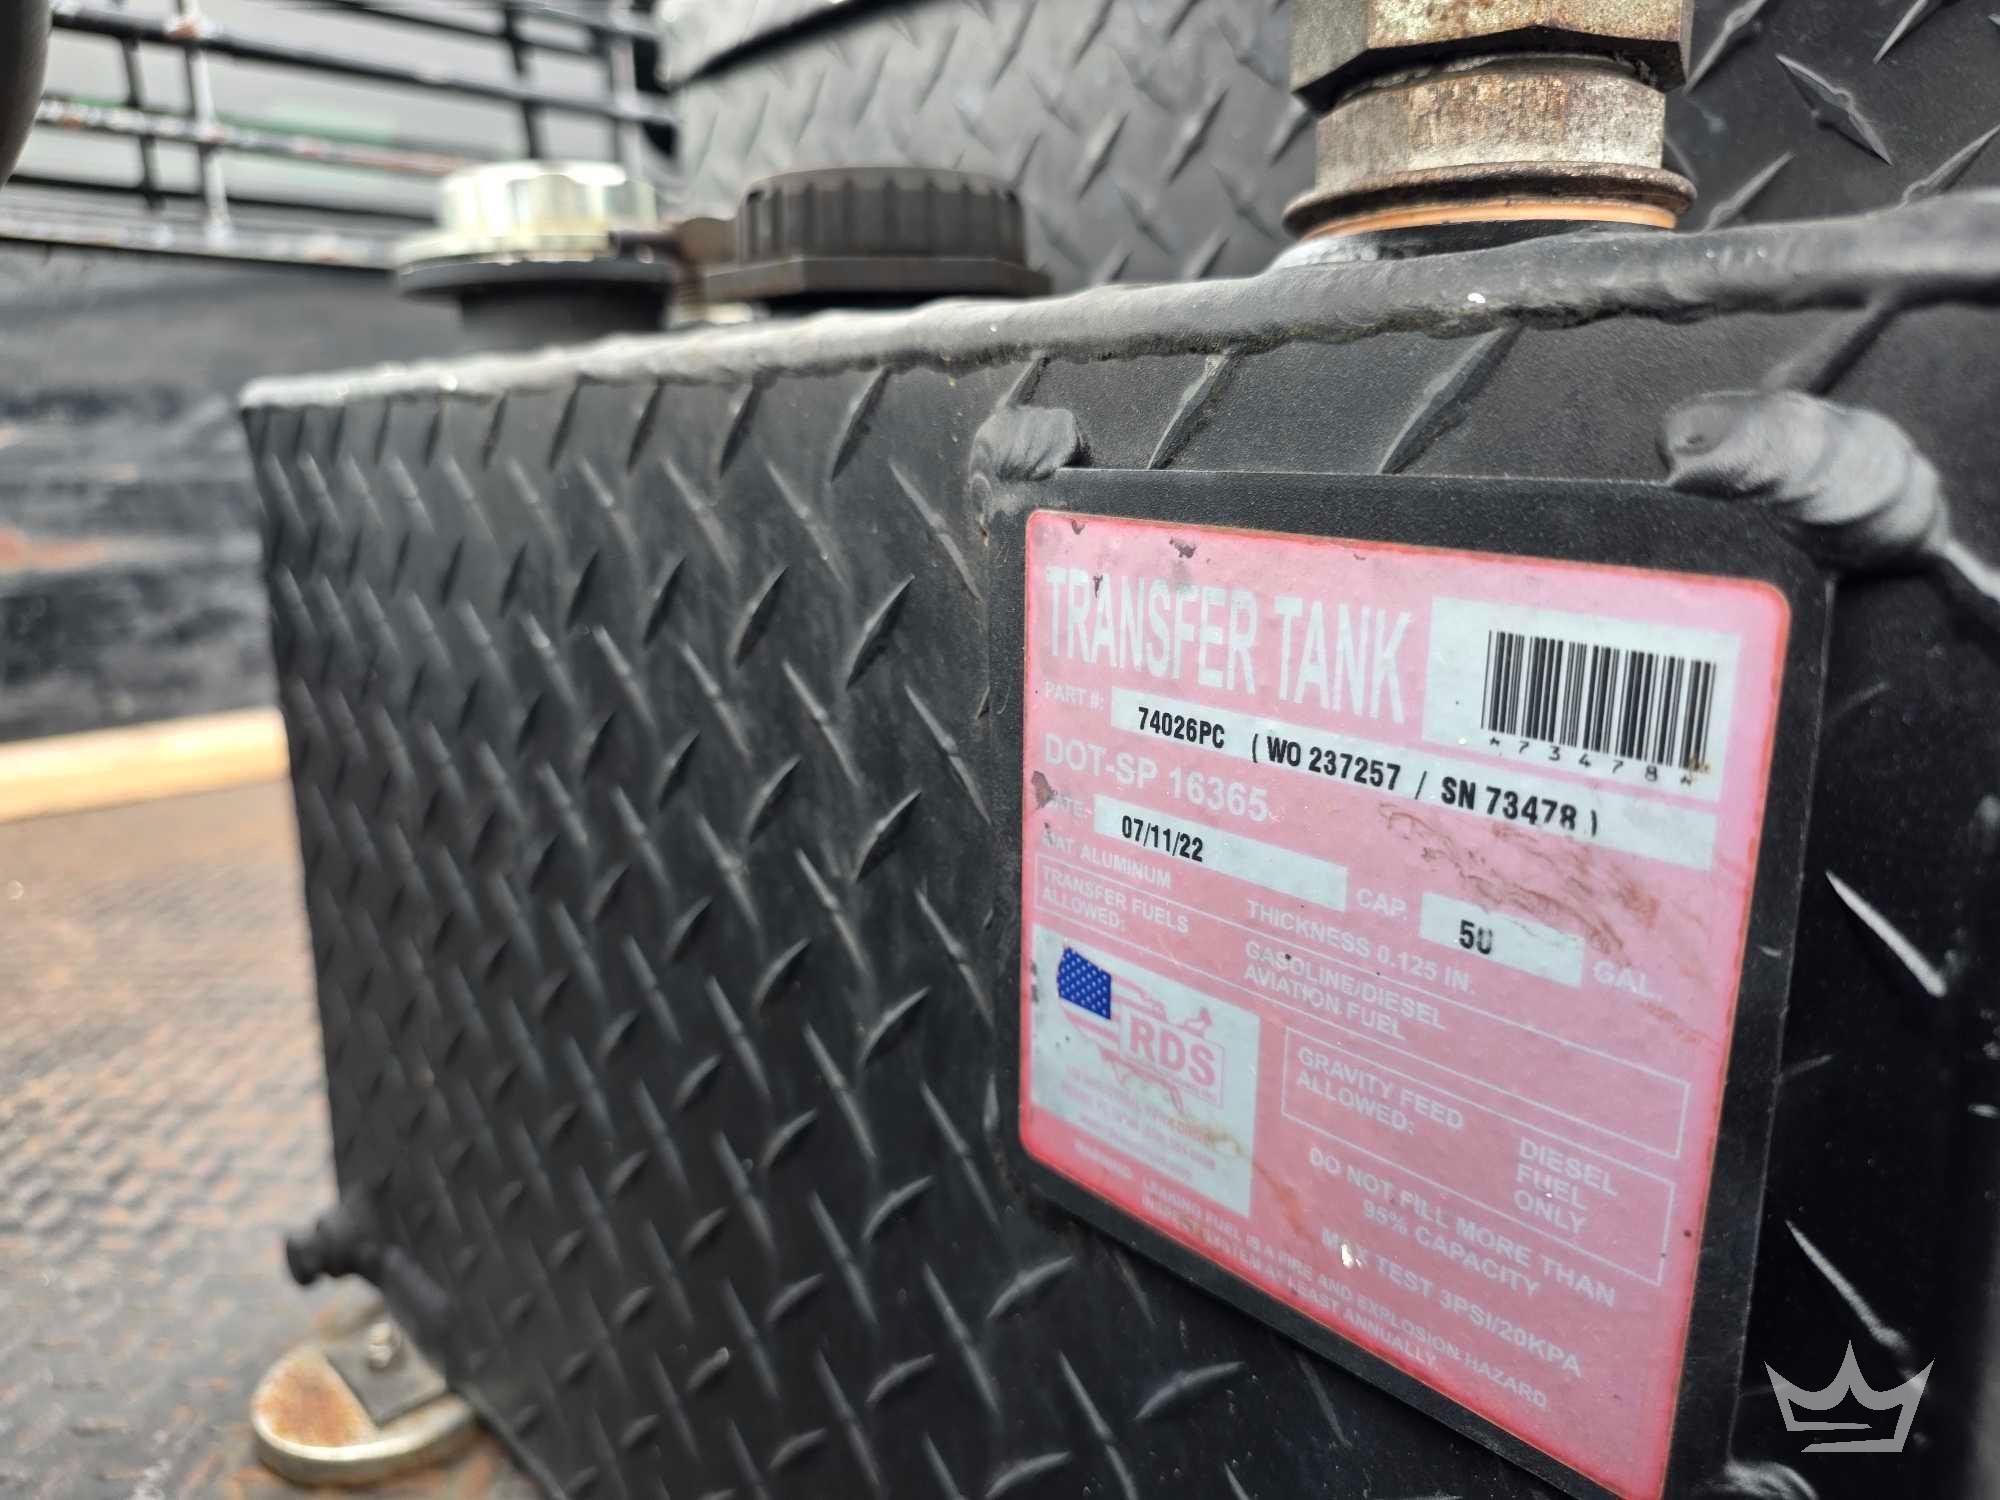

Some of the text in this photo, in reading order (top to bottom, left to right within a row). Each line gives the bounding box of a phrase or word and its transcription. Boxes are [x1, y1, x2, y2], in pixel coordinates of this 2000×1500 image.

[1046, 567, 1411, 724] TRANSFER TANK
[1045, 680, 1087, 705] PART
[1044, 734, 1269, 822] DOT-SP 16365
[1138, 706, 1225, 749] 74026PC
[1267, 735, 1302, 767] WO
[1309, 747, 1401, 790] 237257
[1441, 777, 1476, 811] SN
[1486, 786, 1578, 831] 73478
[1080, 845, 1171, 889] ALUMINUM
[1122, 815, 1203, 862] 07/11/22
[1042, 865, 1189, 933] TRANSFER FUELS
[1458, 919, 1493, 955] 50
[1247, 900, 1372, 959] THICKNESS
[1377, 945, 1437, 981] 0.125
[1244, 965, 1406, 1041] AVIATION FUEL
[1245, 941, 1447, 1030] GASOLINE/DIESEL
[1130, 1015, 1215, 1087] RDS
[1297, 1047, 1464, 1130] GRAVITY FEED
[1297, 1070, 1414, 1135] ALLOWED:
[1517, 1165, 1588, 1210] FUEL
[1519, 1137, 1618, 1196] DIESEL
[1309, 1146, 1617, 1307] DO NOT FILL MORE THAN
[1363, 1200, 1541, 1298] 95% CAPACITY
[1513, 1189, 1589, 1234] ONLY
[1318, 1274, 1352, 1300] AND
[1357, 1294, 1459, 1361] EXPLOSION
[1322, 1227, 1581, 1377] MX TEST 3PSI/20KPA
